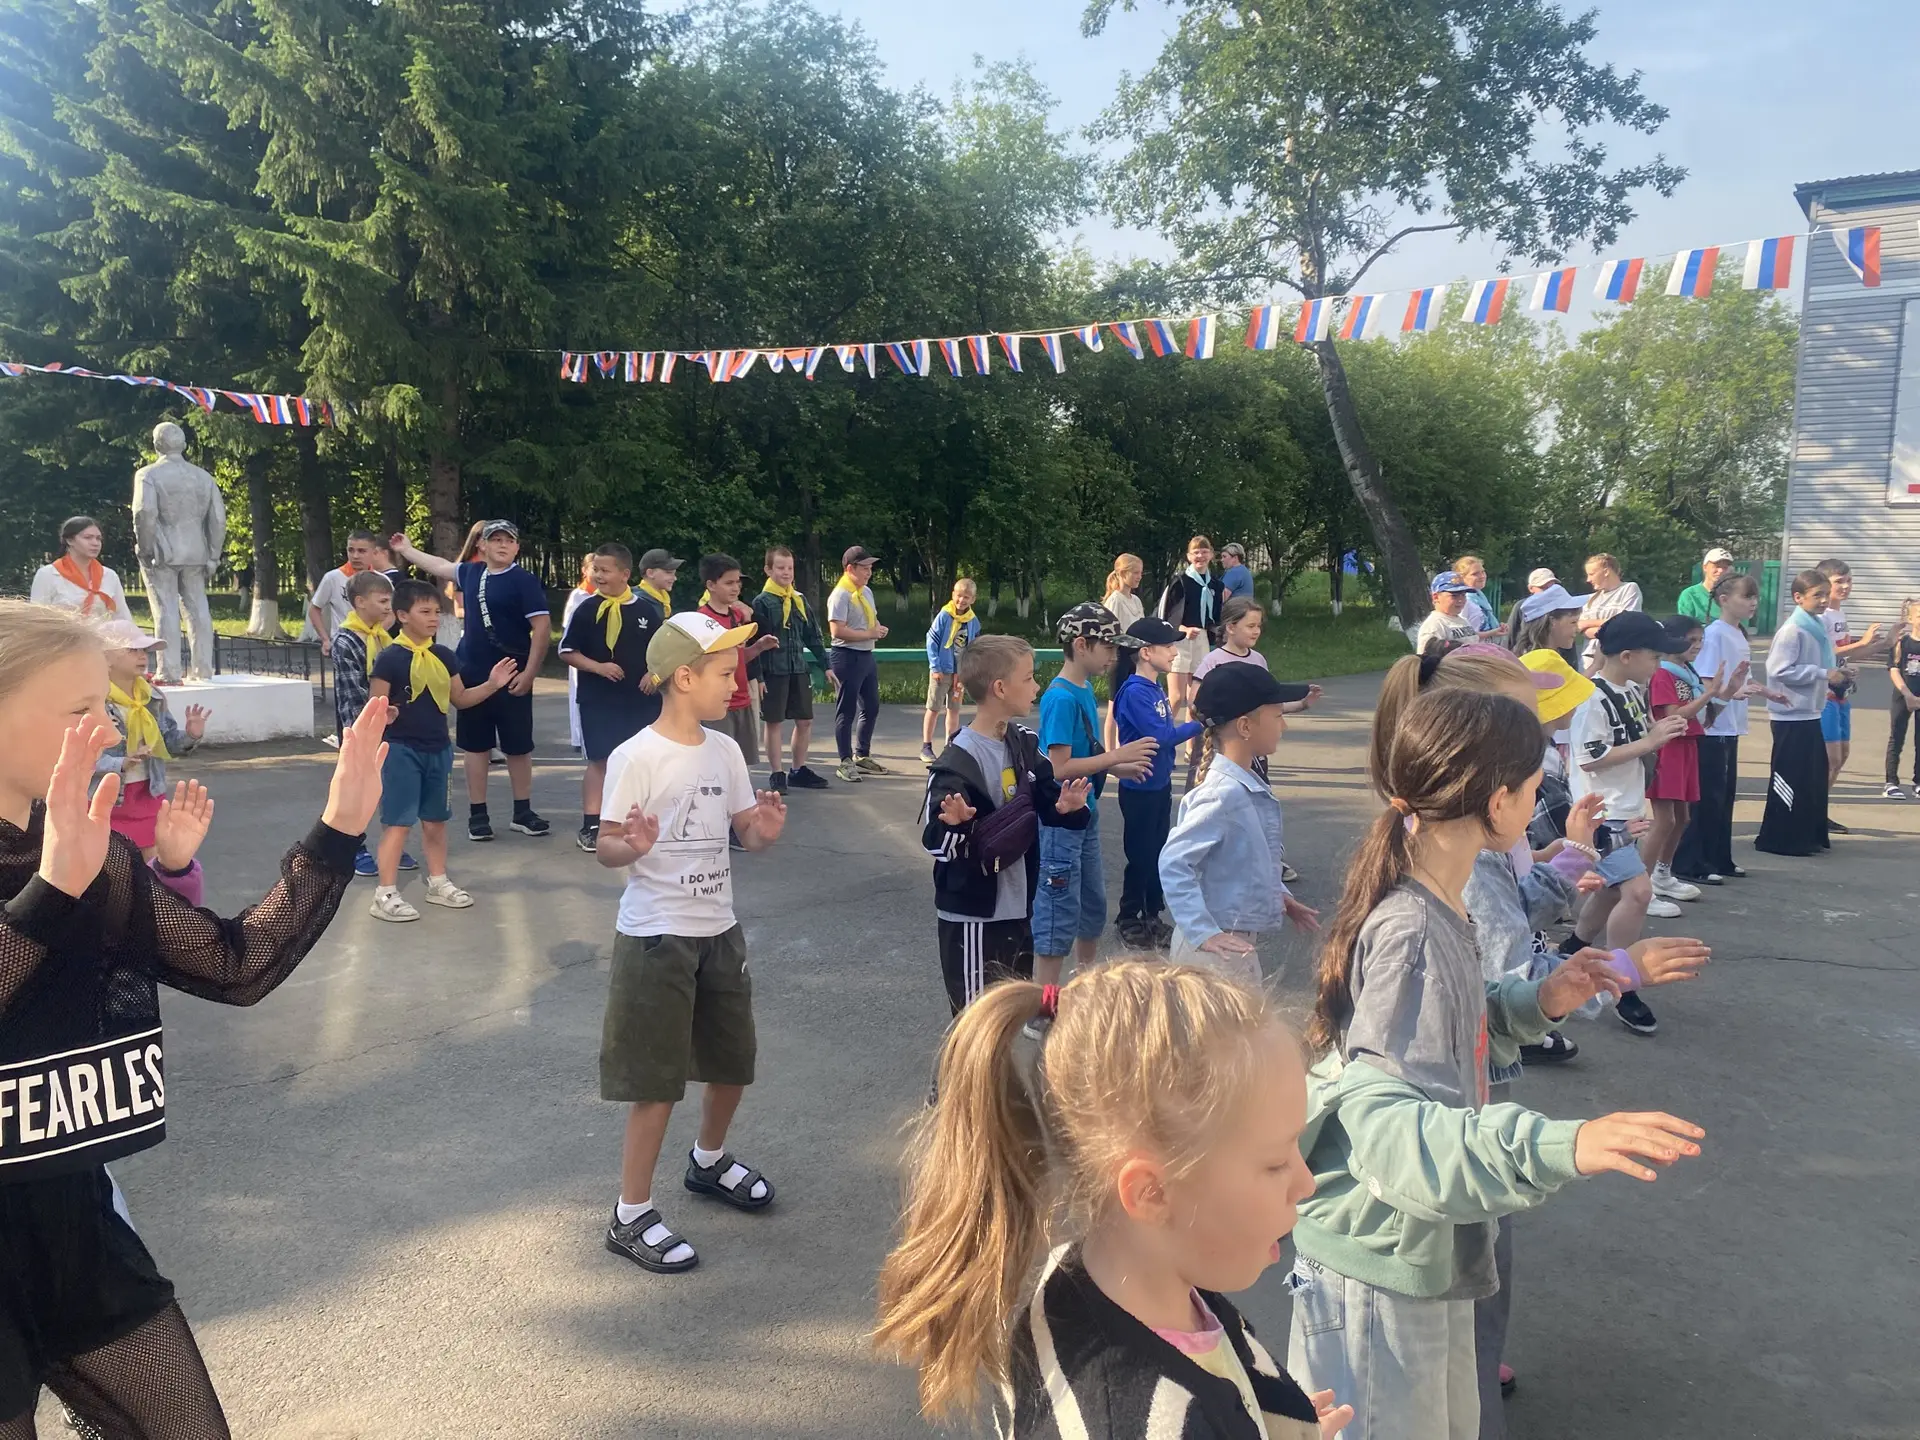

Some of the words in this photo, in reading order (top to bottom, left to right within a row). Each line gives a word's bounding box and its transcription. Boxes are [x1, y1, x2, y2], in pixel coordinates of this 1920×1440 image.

[689, 873, 705, 884] DO
[708, 868, 730, 881] WHAT
[693, 887, 697, 897] I
